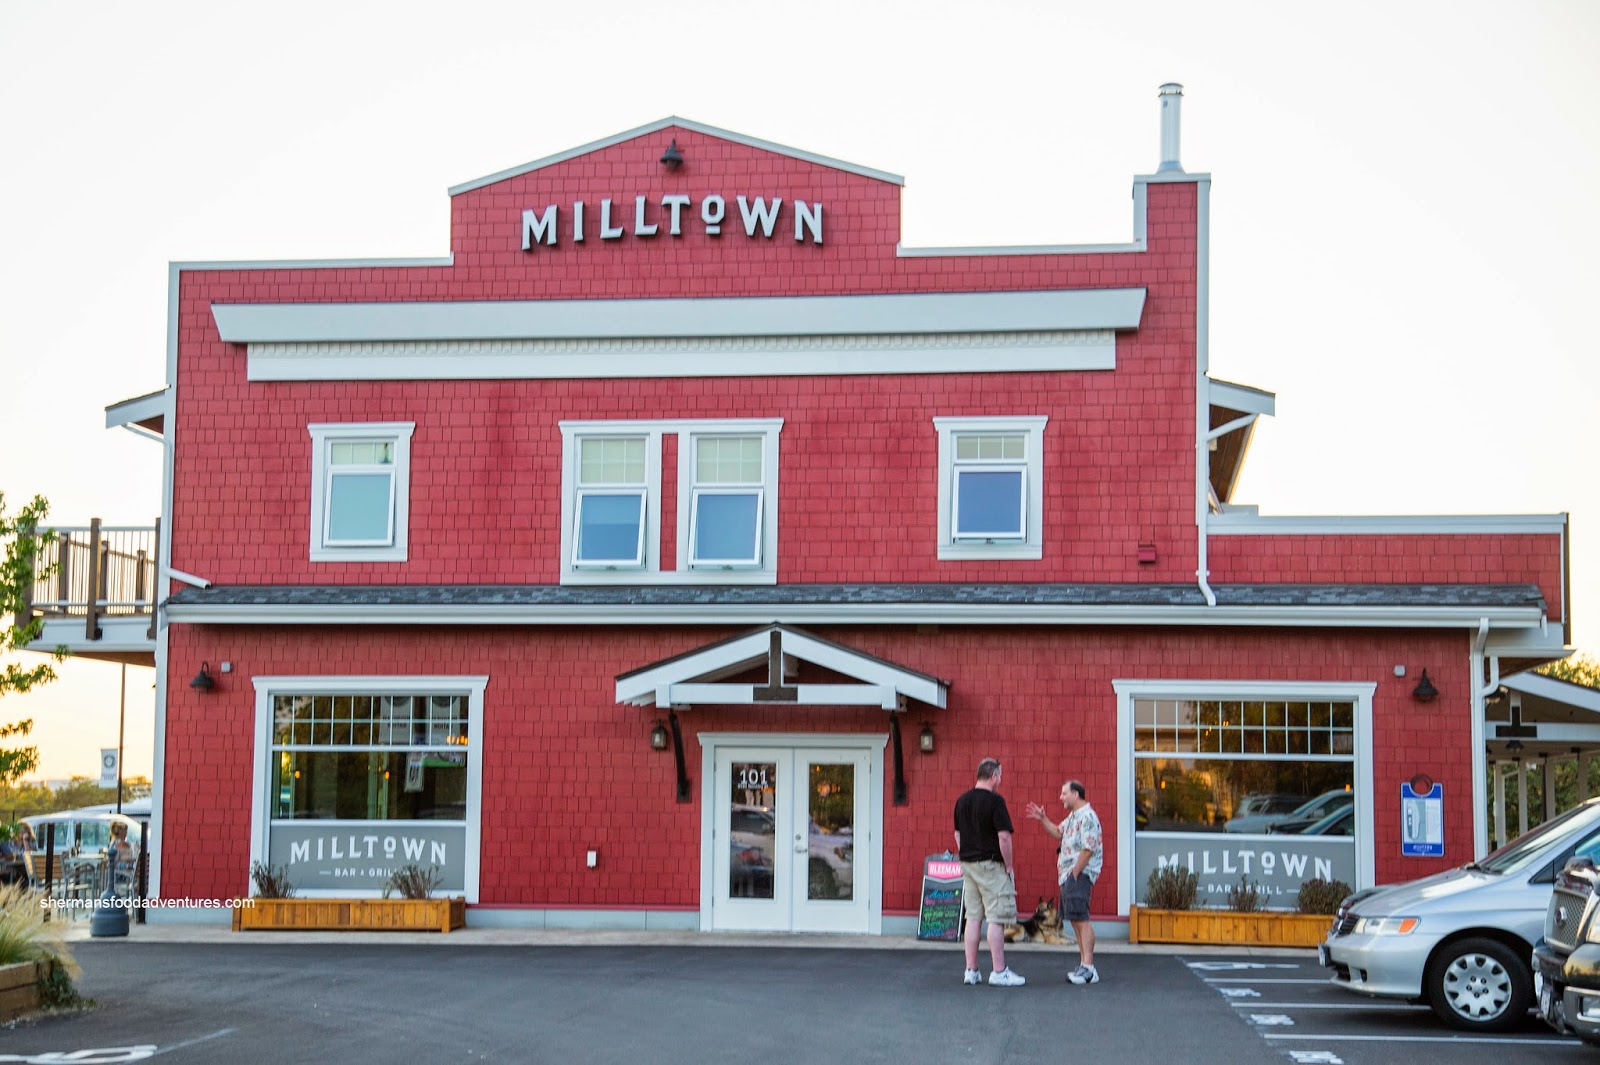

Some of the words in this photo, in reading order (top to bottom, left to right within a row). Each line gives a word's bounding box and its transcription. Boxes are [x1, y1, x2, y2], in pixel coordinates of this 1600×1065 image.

[521, 194, 822, 250] MILLTOWN
[739, 769, 767, 784] 101
[290, 835, 446, 866] MILLTOWN
[334, 867, 356, 877] BAR
[1157, 850, 1332, 883] MILLTOWN
[1207, 883, 1231, 894] BAR
